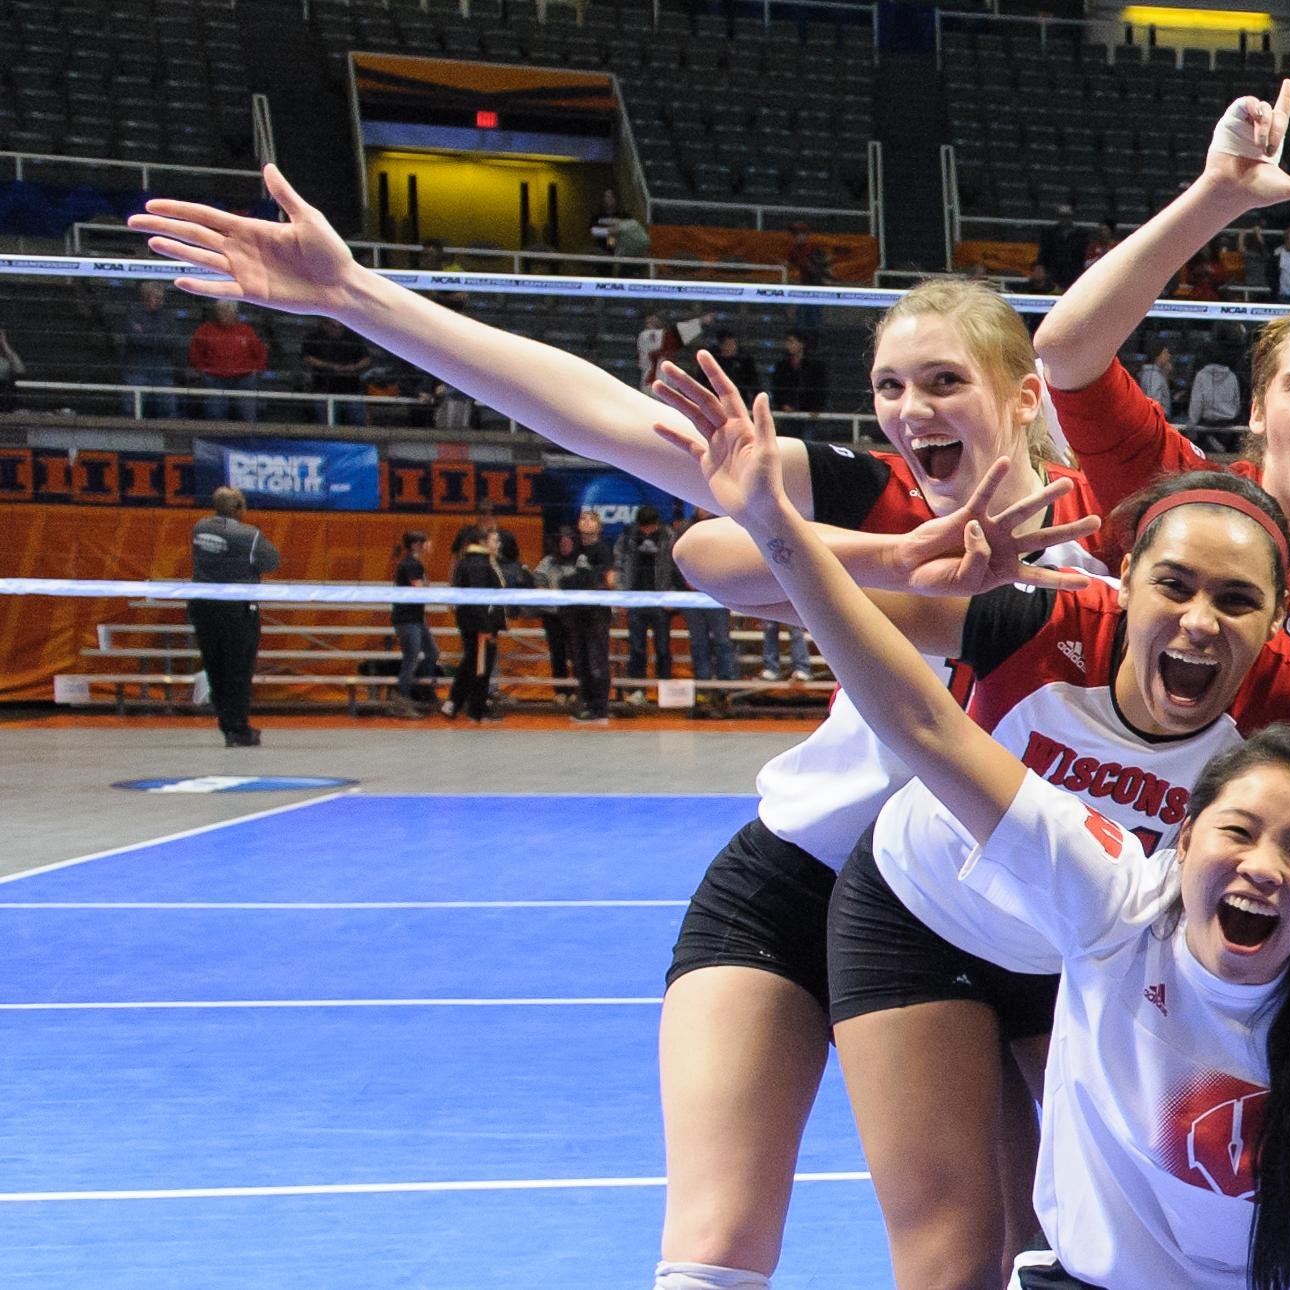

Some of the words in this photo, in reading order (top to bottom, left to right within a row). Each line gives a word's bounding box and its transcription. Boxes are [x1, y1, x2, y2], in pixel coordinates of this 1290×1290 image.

[93, 262, 125, 271] NCAA
[430, 276, 461, 285] NCAA
[1220, 306, 1248, 314] NCAA
